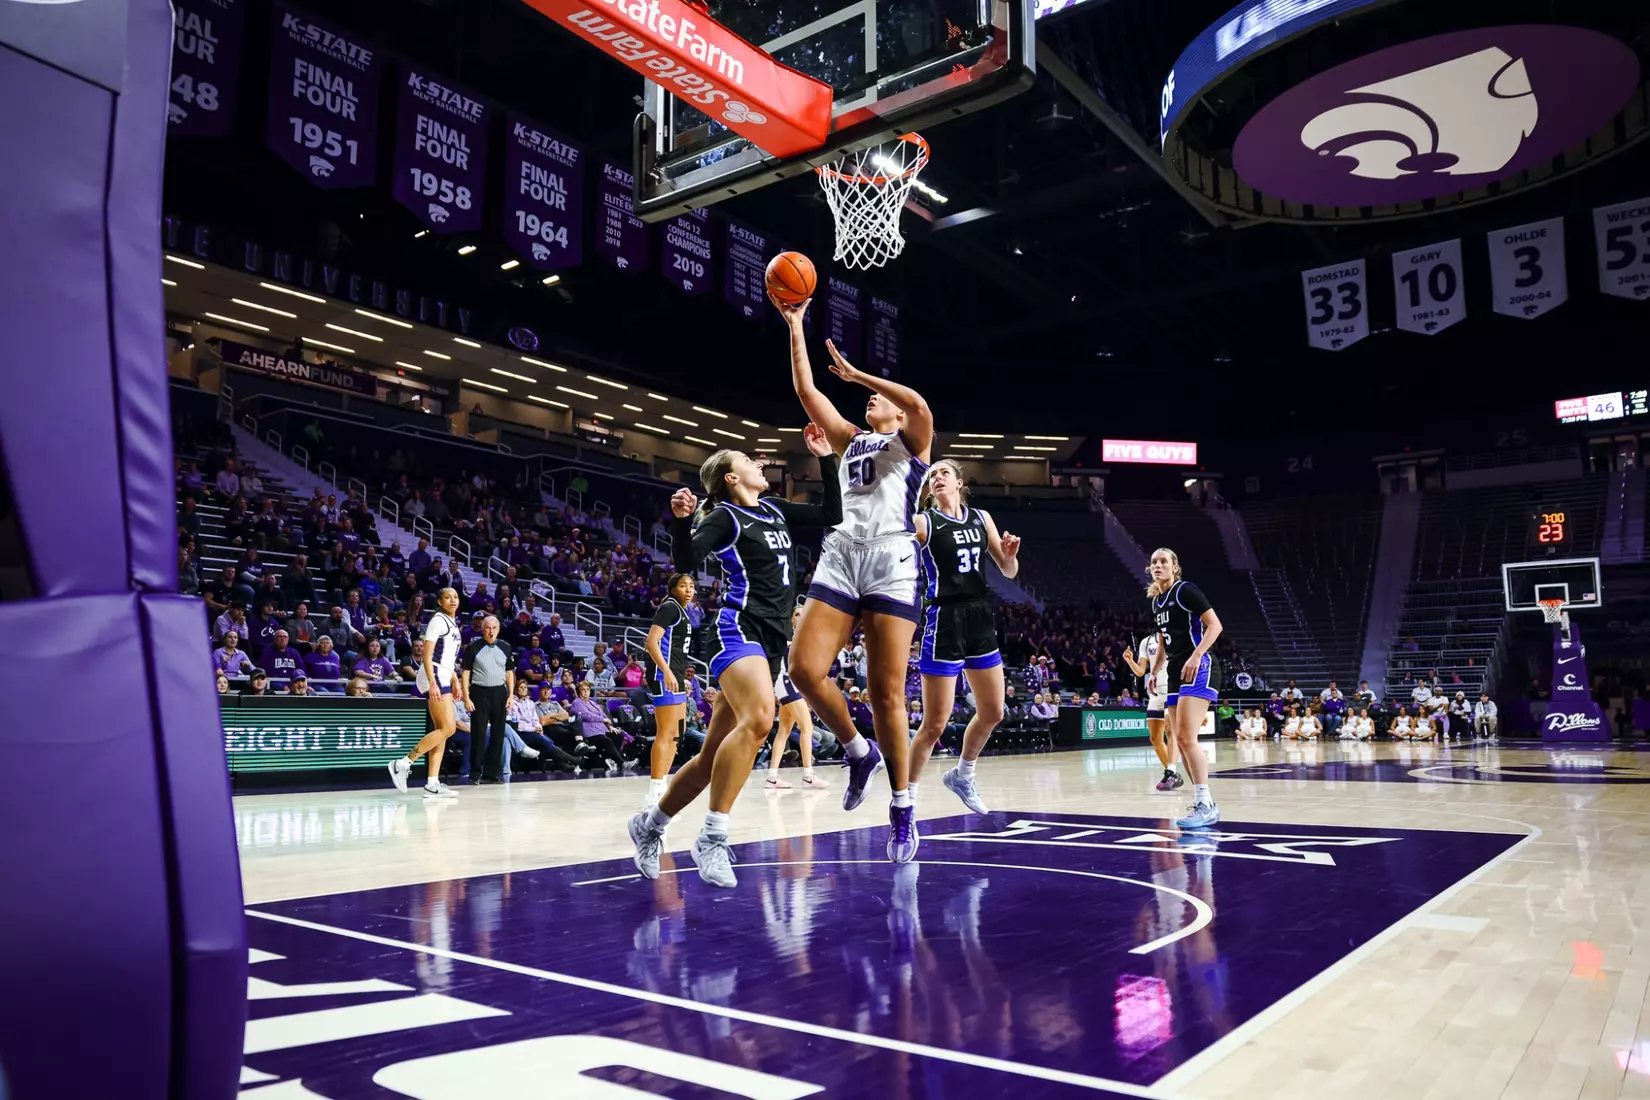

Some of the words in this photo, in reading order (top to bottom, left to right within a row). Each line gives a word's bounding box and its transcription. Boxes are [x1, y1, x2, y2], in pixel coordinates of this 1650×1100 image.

[282, 12, 373, 66] K-STATE
[288, 30, 316, 49] MEN'S
[316, 43, 367, 72] BASKETBALL
[171, 73, 220, 111] 48
[294, 57, 359, 103] FINAL
[293, 77, 356, 122] FOUR
[407, 71, 484, 119] K-STATE
[412, 88, 435, 105] MEN'S
[435, 99, 479, 124] BASKETBALL
[289, 116, 358, 166] 1951
[416, 113, 471, 153] FINAL
[513, 121, 579, 163] K-STATE
[415, 132, 468, 171] FOUR
[517, 137, 537, 153] MEN'S
[537, 145, 574, 168] BASKETBALL
[521, 160, 568, 195] FINAL
[603, 163, 634, 185] K-STA
[410, 167, 472, 210] 1958
[520, 177, 566, 212] FOUR
[604, 193, 625, 209] ELITE
[606, 207, 622, 220] 1981
[627, 216, 643, 229] 2023
[515, 210, 569, 249] 1964
[605, 226, 622, 239] 2010
[667, 224, 711, 249] CONFERENCE
[677, 217, 691, 231] BIG
[692, 221, 701, 235] 12
[729, 223, 766, 247] K-STATE
[1504, 228, 1547, 245] OHLDE
[605, 235, 621, 248] 2018
[666, 233, 711, 259] CHAMPIONS
[673, 253, 704, 278] 2019
[1410, 250, 1442, 265] GARY
[1512, 246, 1543, 288] 3
[828, 276, 860, 298] K-STATE
[1307, 267, 1360, 285] ROMSTAD
[1400, 262, 1457, 307] 10
[1310, 281, 1362, 326] 33
[1509, 291, 1552, 305] 2000-04
[1412, 307, 1450, 322] 1981-83
[1319, 324, 1355, 338] 1979-82
[1595, 402, 1615, 415] 46
[1103, 444, 1142, 459] FIVE
[1146, 446, 1194, 461] GUYS
[1288, 454, 1313, 472] 24
[848, 457, 876, 488] 50
[1542, 512, 1565, 524] 7:00
[763, 530, 792, 549] EIU
[953, 528, 981, 545] EIU
[1539, 524, 1563, 542] 23
[777, 554, 790, 586] 7
[1156, 610, 1170, 626] EIU
[1098, 719, 1112, 731] OLD
[1113, 719, 1146, 730] DOMINION
[1545, 712, 1601, 733] Dillons
[223, 726, 326, 751] EIGHT
[336, 726, 402, 750] LINE
